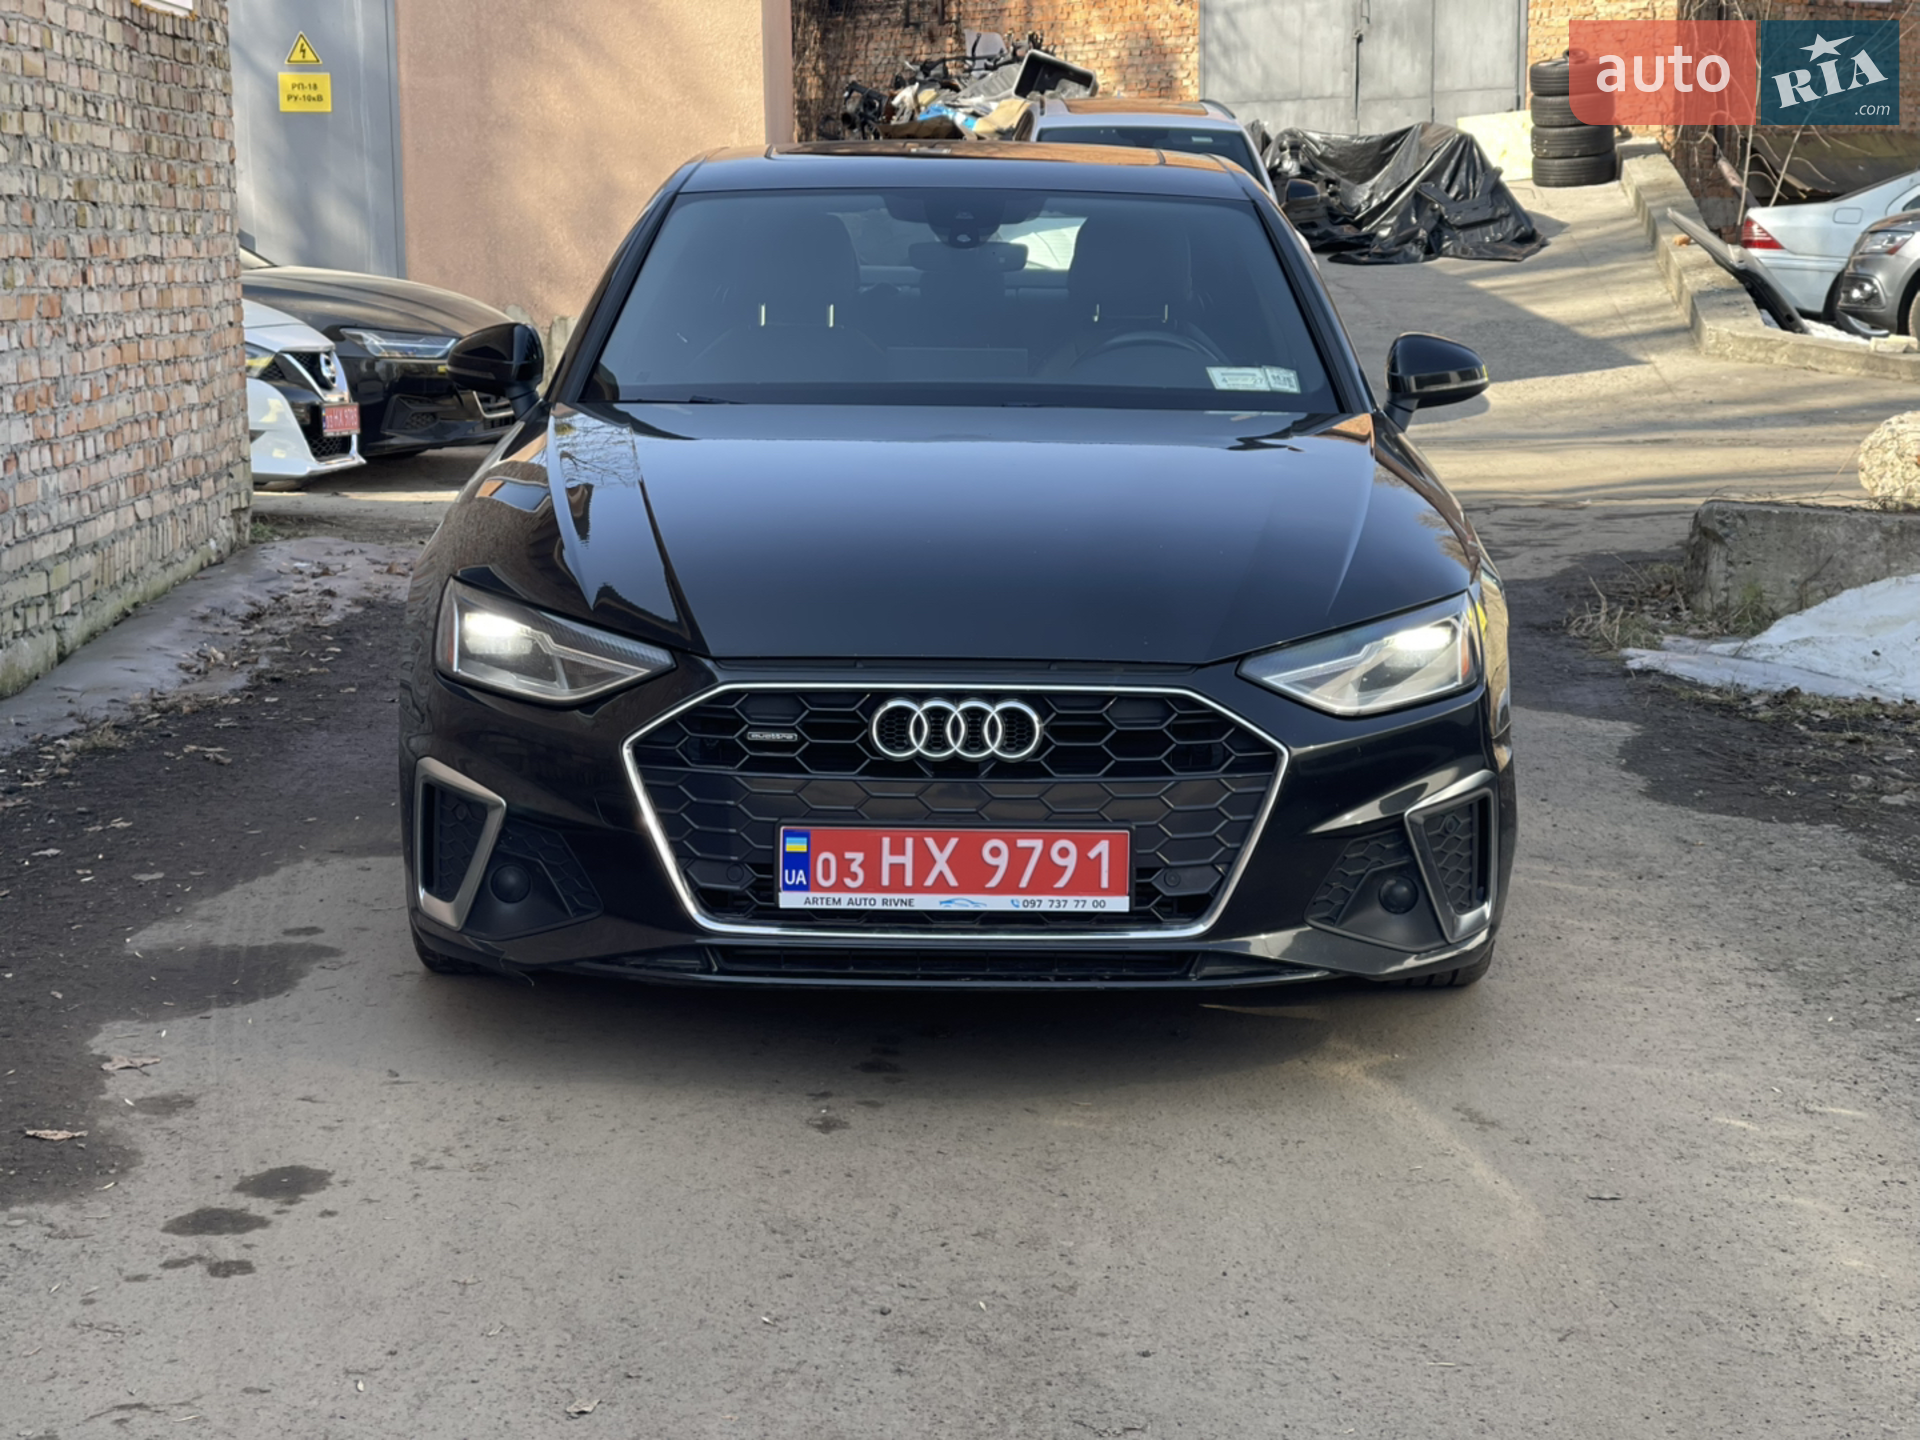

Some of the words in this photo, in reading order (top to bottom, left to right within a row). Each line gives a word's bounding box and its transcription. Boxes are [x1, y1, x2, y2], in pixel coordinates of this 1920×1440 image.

[815, 851, 865, 889] 03
[881, 836, 960, 888] HX
[981, 838, 1110, 889] 9791
[784, 869, 807, 886] UA
[803, 896, 842, 906] ARTEM
[846, 897, 877, 907] AUTO
[881, 897, 915, 908] RIVNE
[1022, 899, 1043, 909] 097
[1048, 899, 1068, 909] 737
[1073, 899, 1087, 909] 77
[1092, 899, 1107, 909] 00
